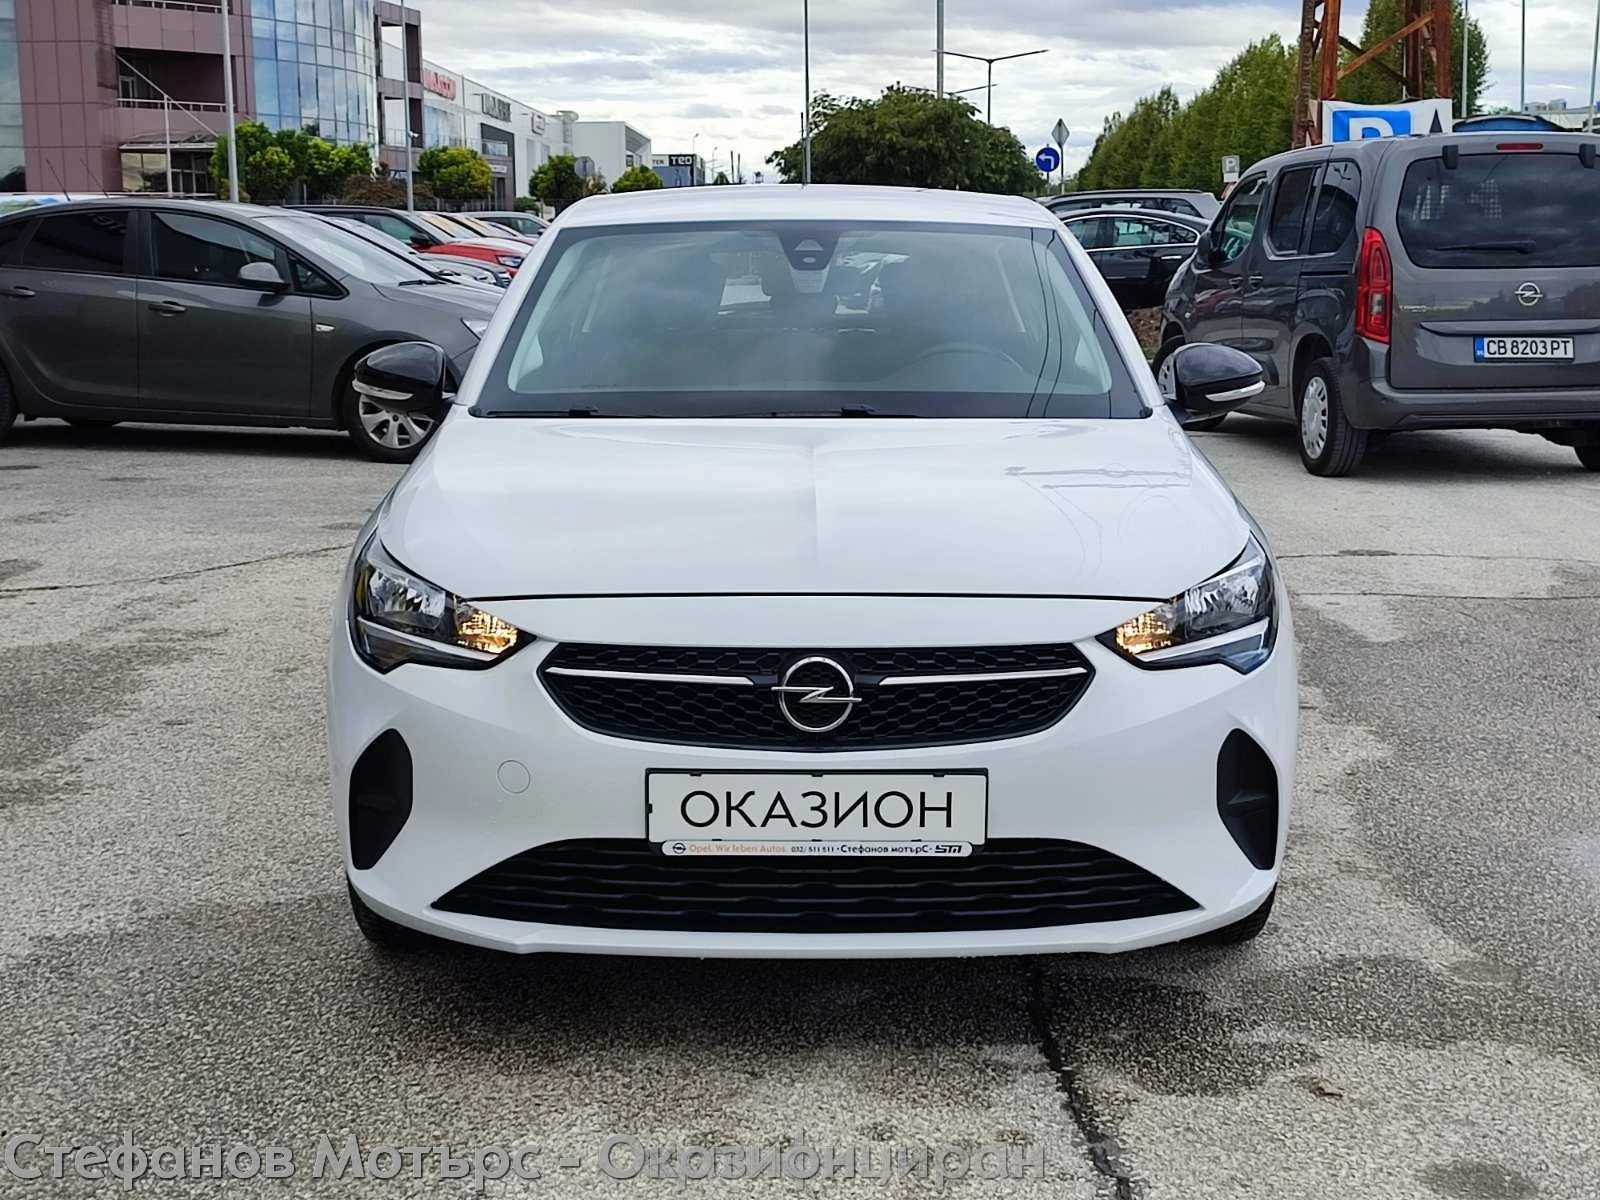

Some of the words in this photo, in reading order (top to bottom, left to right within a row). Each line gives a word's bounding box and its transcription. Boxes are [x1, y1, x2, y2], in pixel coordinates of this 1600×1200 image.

[1486, 339, 1507, 356] CB
[1510, 339, 1548, 356] 8203
[1550, 340, 1570, 356] PT
[680, 789, 953, 829] ОКАЗИОН
